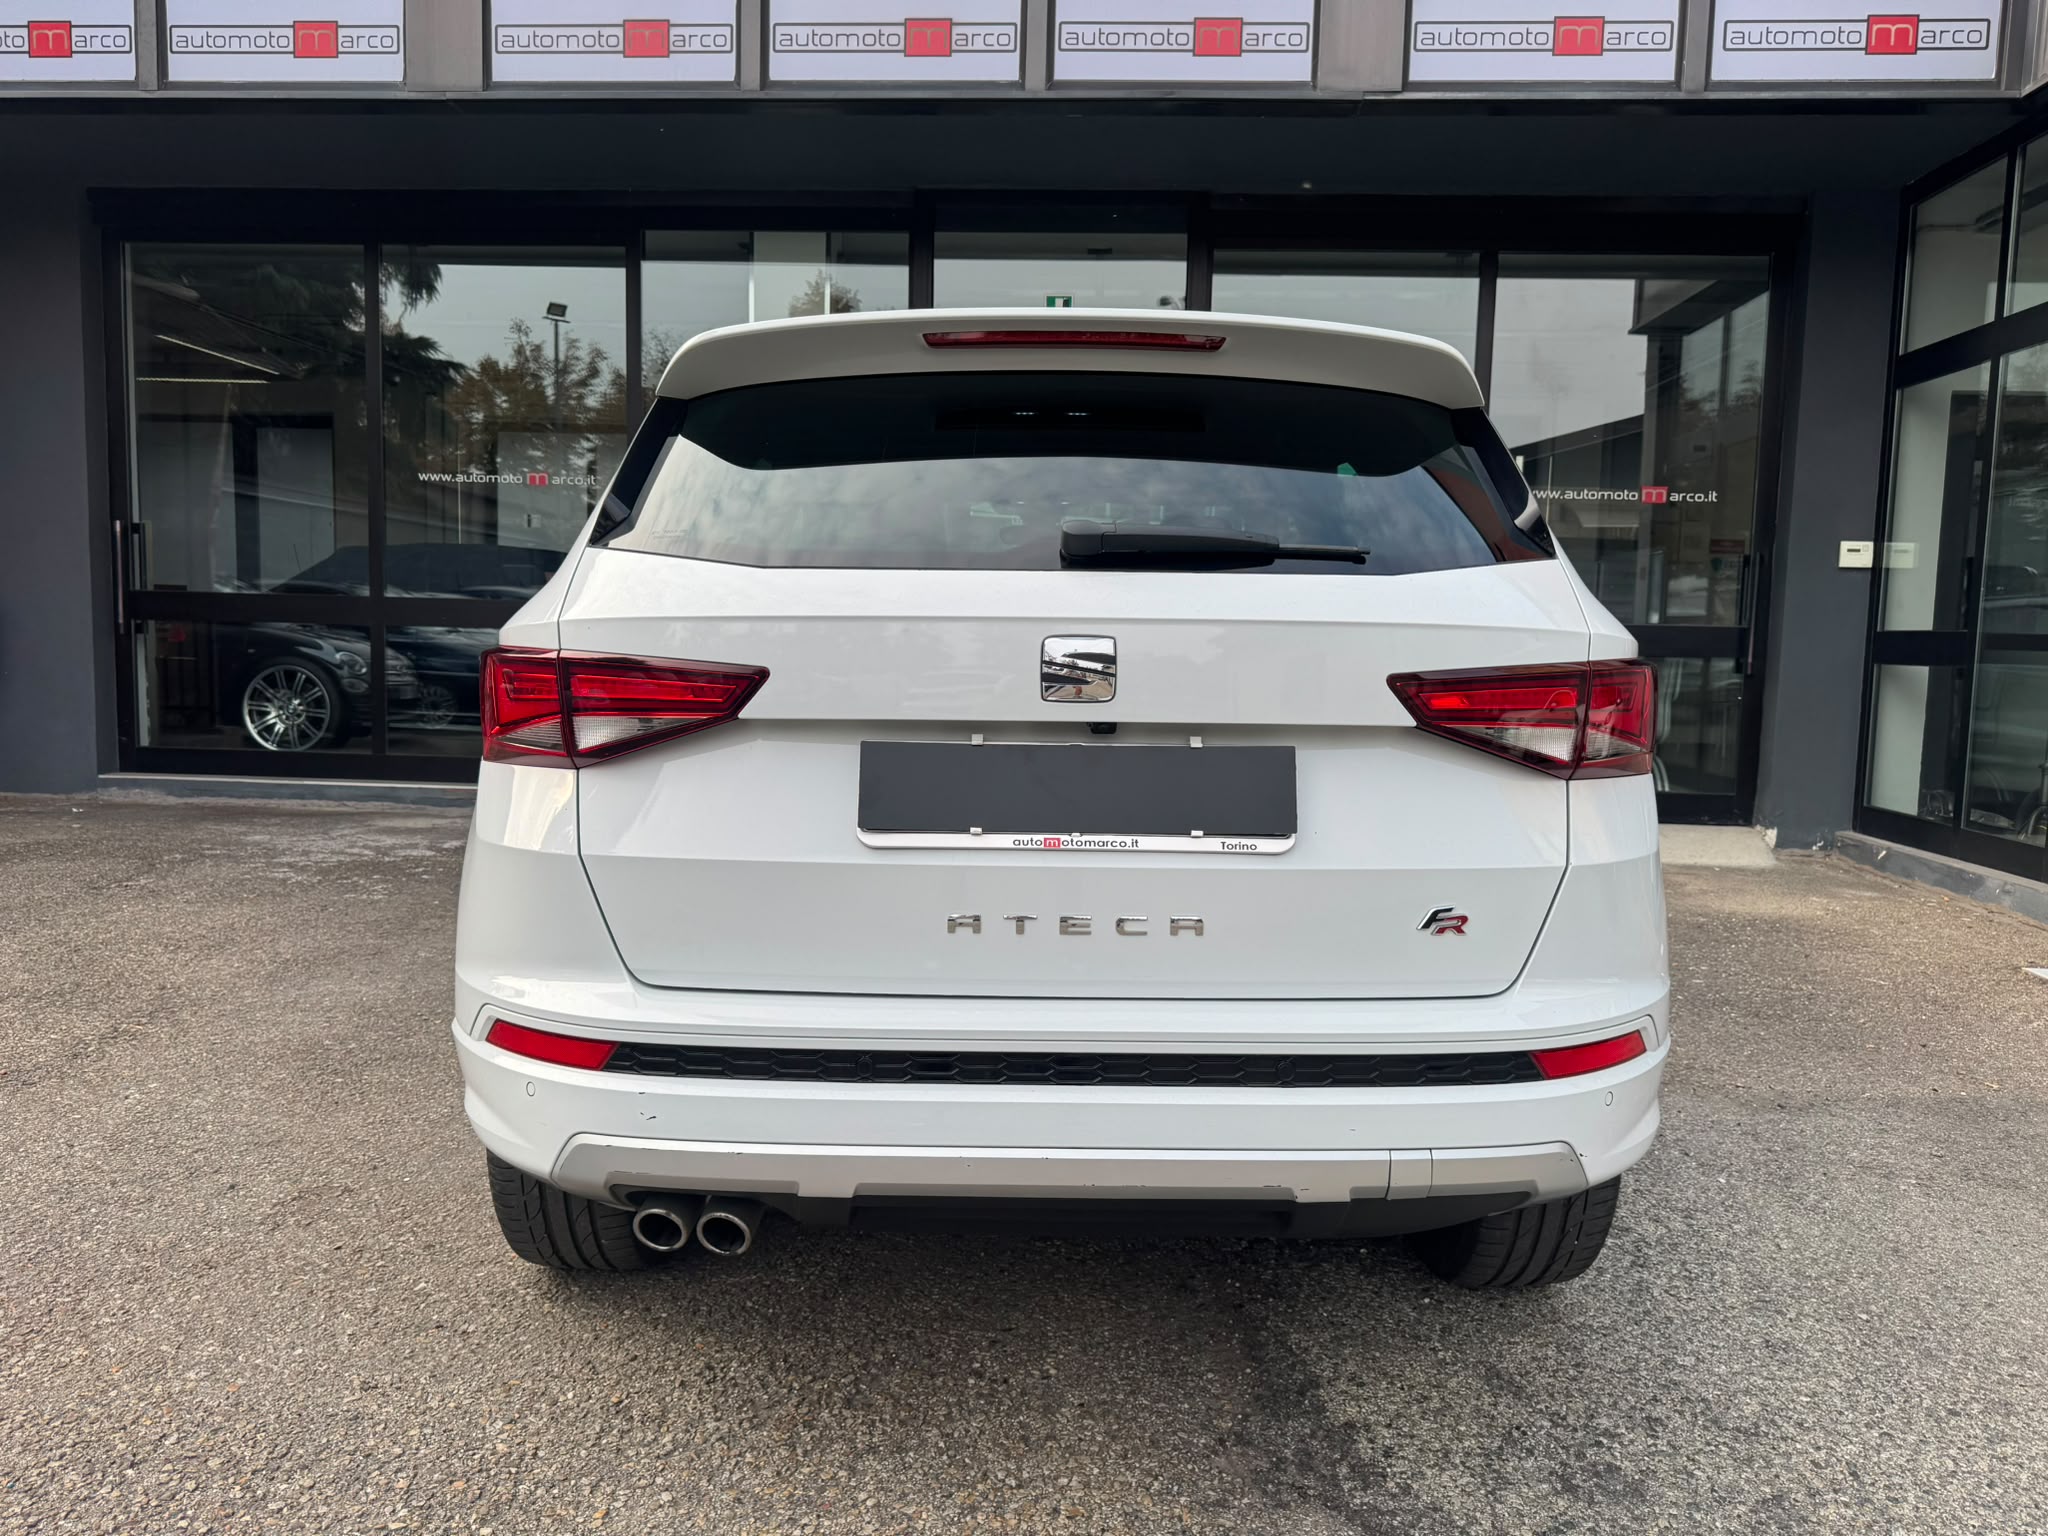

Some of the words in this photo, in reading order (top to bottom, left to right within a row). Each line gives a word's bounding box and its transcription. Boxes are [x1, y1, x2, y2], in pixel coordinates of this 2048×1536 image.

[1012, 836, 1140, 849] automotomarco.it
[1220, 841, 1258, 851] Torino
[947, 914, 1204, 936] ATECA
[1416, 904, 1469, 936] FR
